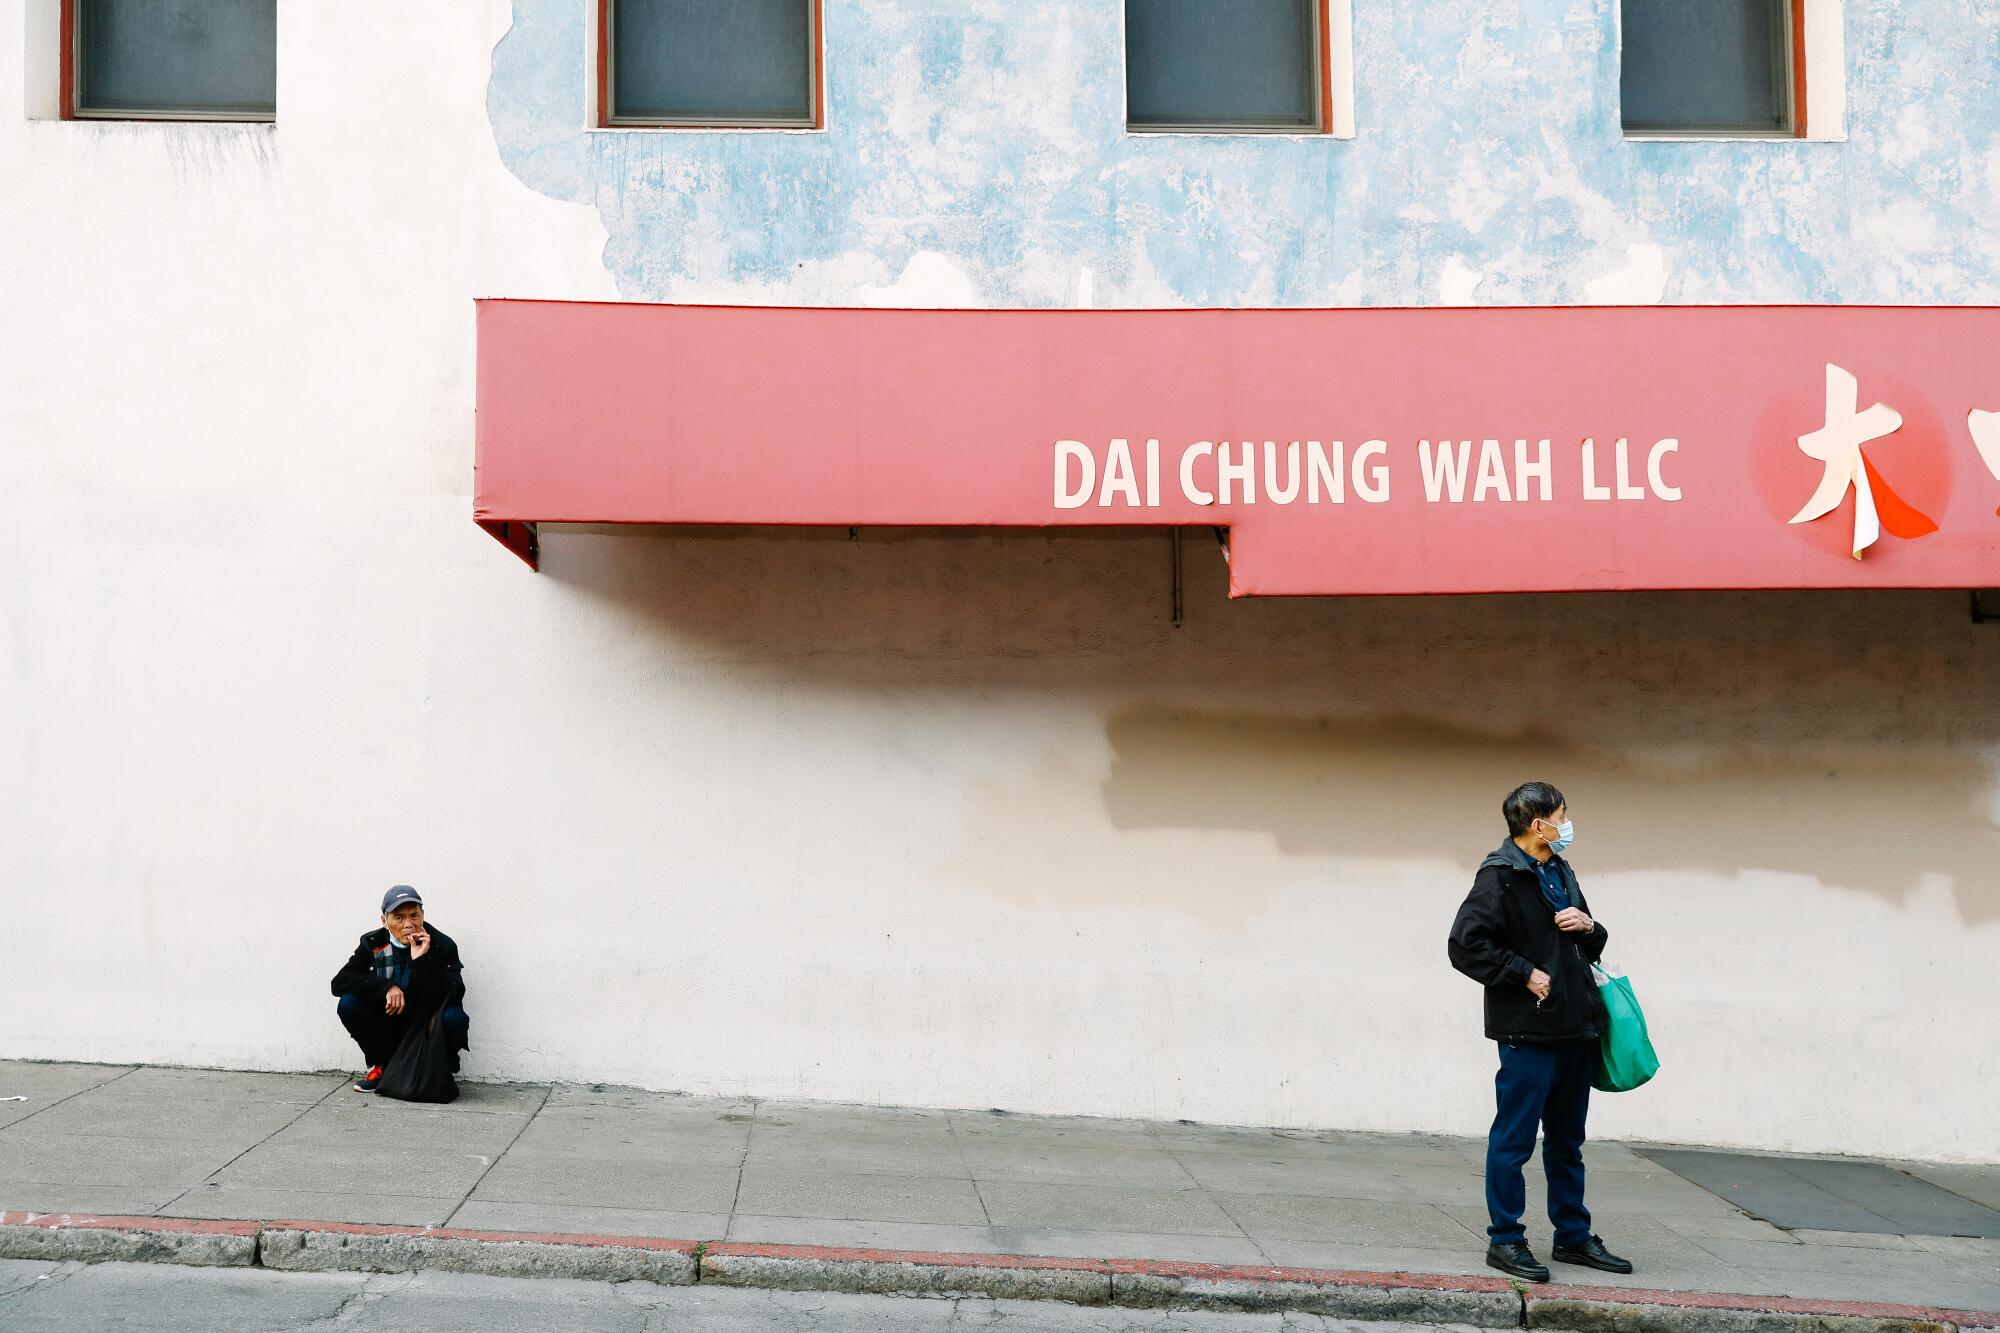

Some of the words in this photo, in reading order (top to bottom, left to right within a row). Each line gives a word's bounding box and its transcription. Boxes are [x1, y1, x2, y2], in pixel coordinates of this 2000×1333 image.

[1053, 440, 1160, 509] DAI
[1179, 439, 1390, 506] CHUNG
[1417, 438, 1553, 503] WAH
[1580, 437, 1683, 501] LLC
[1787, 362, 2000, 561] 大
